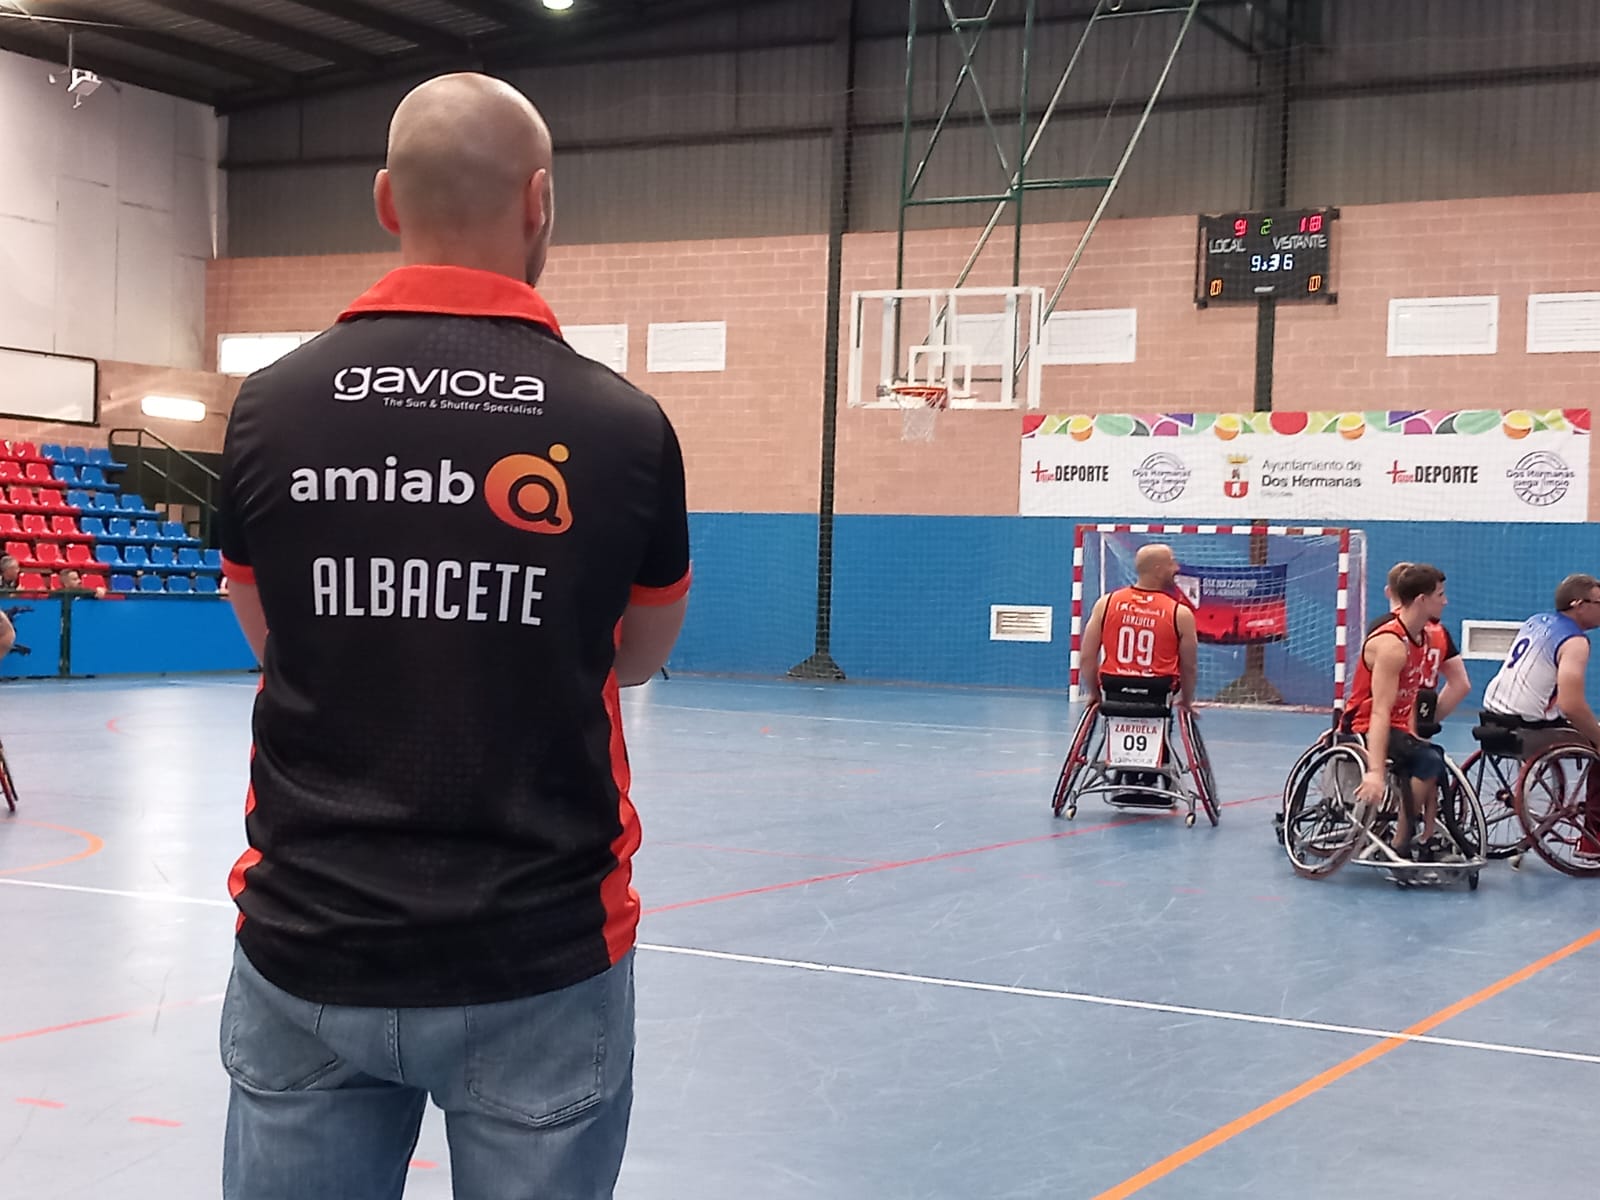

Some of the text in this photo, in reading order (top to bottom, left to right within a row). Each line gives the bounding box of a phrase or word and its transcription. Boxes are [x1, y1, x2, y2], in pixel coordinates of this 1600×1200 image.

[1260, 218, 1273, 235] 2
[1209, 238, 1246, 253] LOCAL
[333, 366, 545, 402] gaviota
[383, 397, 544, 415] The Sun & Shutter Specialists
[1055, 465, 1109, 482] DEPORTE
[1262, 459, 1362, 473] Ayuntamiento de
[1415, 465, 1478, 483] DEPORTE
[289, 455, 475, 504] amiab
[1262, 474, 1361, 487] Dos Hermanas
[312, 556, 547, 626] ALBACETE
[1117, 626, 1154, 666] 09
[1507, 638, 1530, 668] 9
[1115, 723, 1157, 734] ZARZUELA
[1123, 735, 1147, 751] 09
